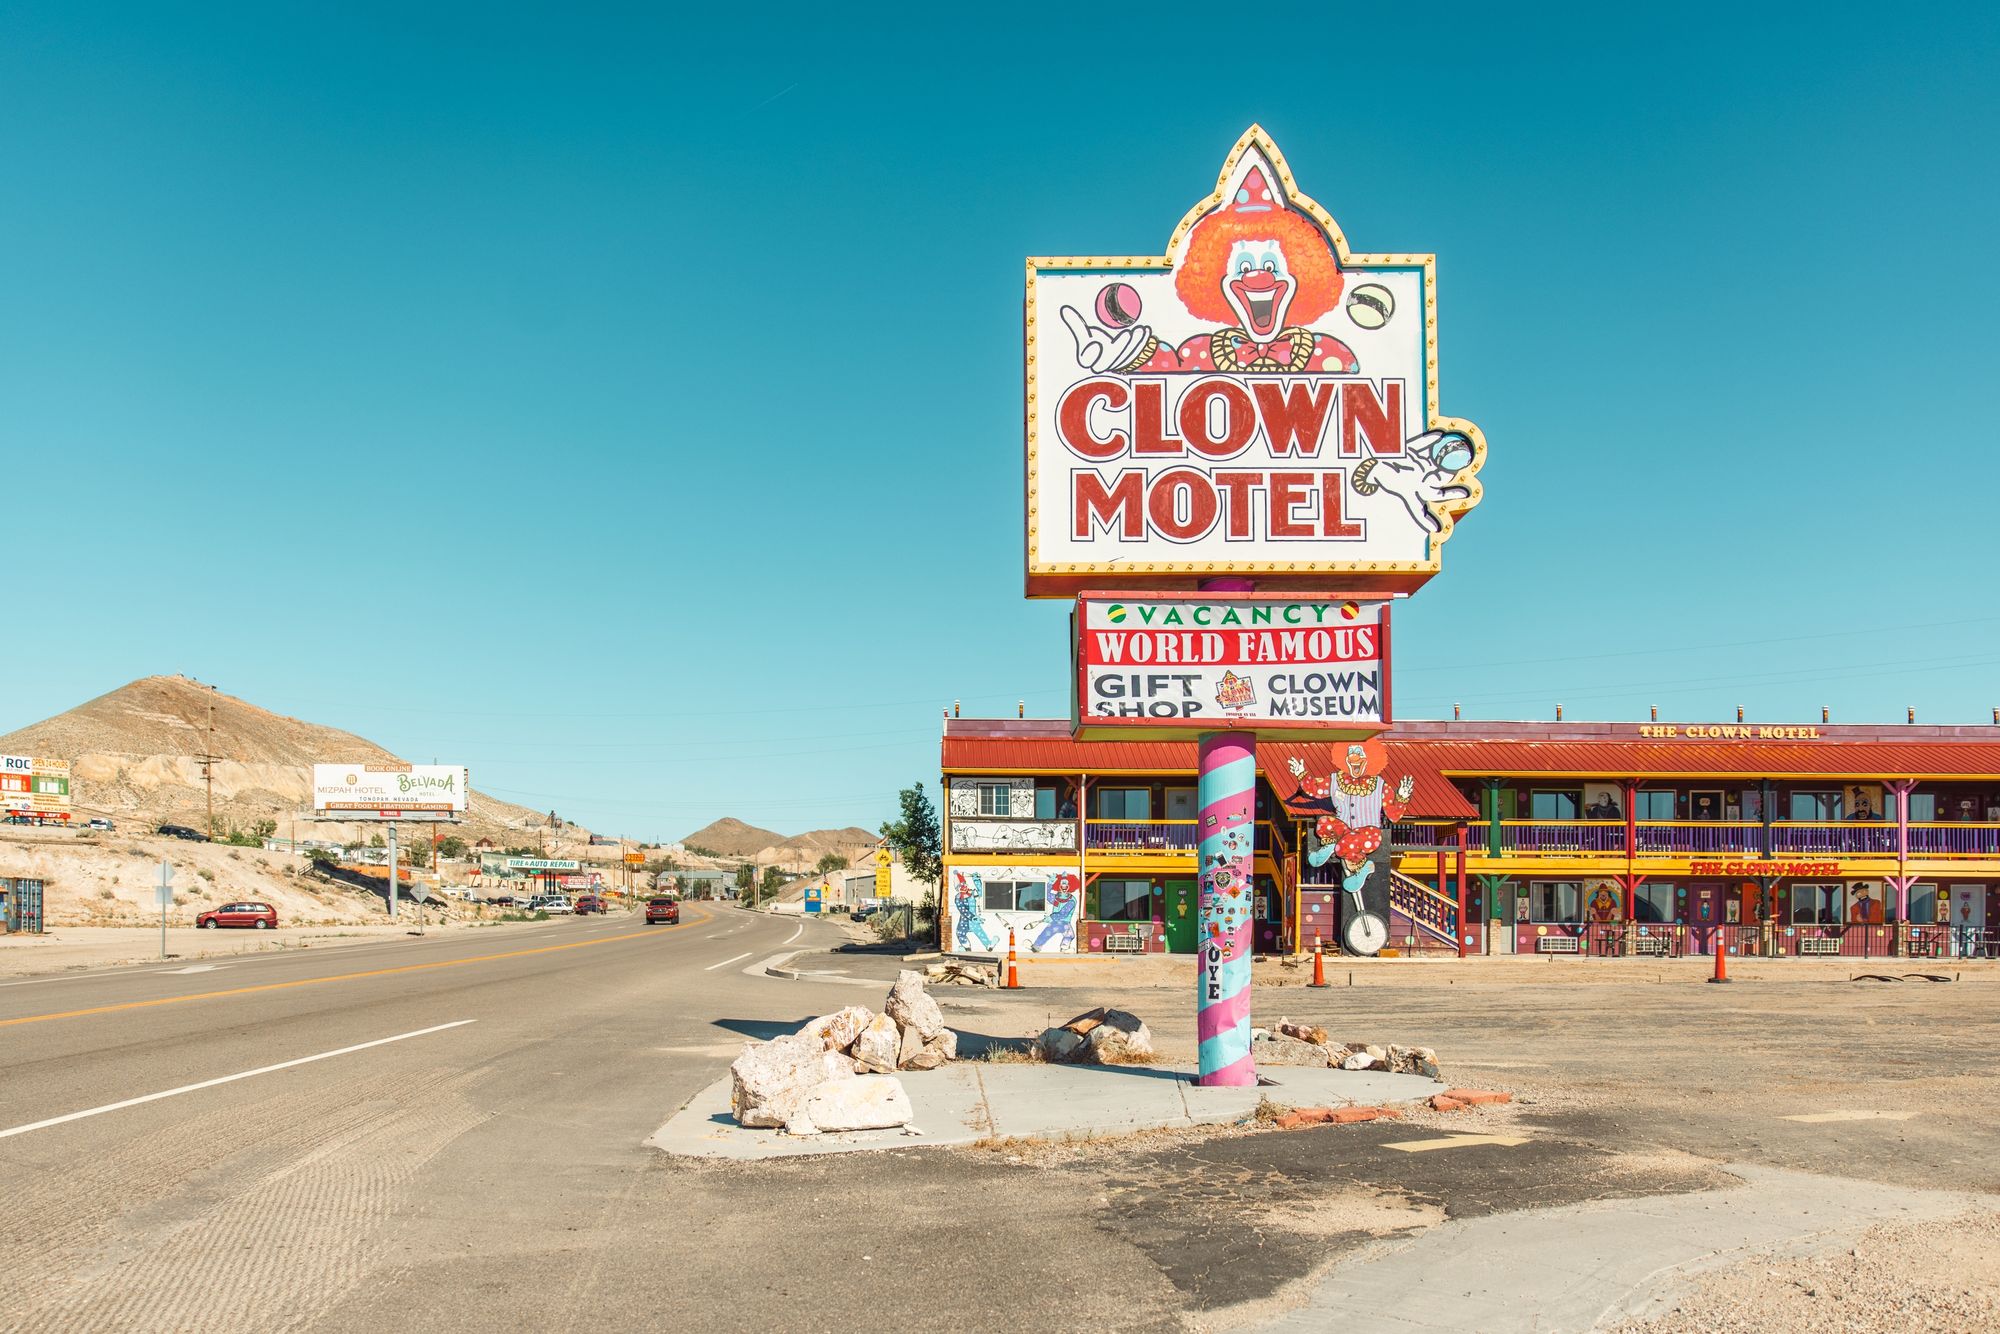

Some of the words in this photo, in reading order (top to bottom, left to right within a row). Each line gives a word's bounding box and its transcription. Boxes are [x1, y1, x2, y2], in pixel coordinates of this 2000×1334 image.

[1056, 378, 1405, 459] CLOWN
[1072, 467, 1366, 541] MOTEL
[1137, 603, 1330, 625] VACANCY
[1096, 631, 1225, 663] WORLD
[1238, 627, 1375, 662] FAMOUS
[1094, 673, 1203, 698] GIFT
[1221, 687, 1251, 698] CLOWN
[1268, 670, 1379, 695] CLOWN
[1096, 701, 1203, 718] SHOP
[1269, 695, 1380, 716] MUSEUM
[1640, 726, 1677, 738] THE
[1685, 726, 1752, 739] CLOWN
[1759, 727, 1820, 739] MOTEL
[6, 758, 30, 769] ROC
[317, 786, 352, 794] MIZPAH
[354, 786, 384, 794] HOTEL
[397, 774, 455, 793] BELVADA
[1689, 862, 1724, 875] THE
[1726, 862, 1786, 876] CLOWN
[1787, 863, 1842, 876] MOTEL
